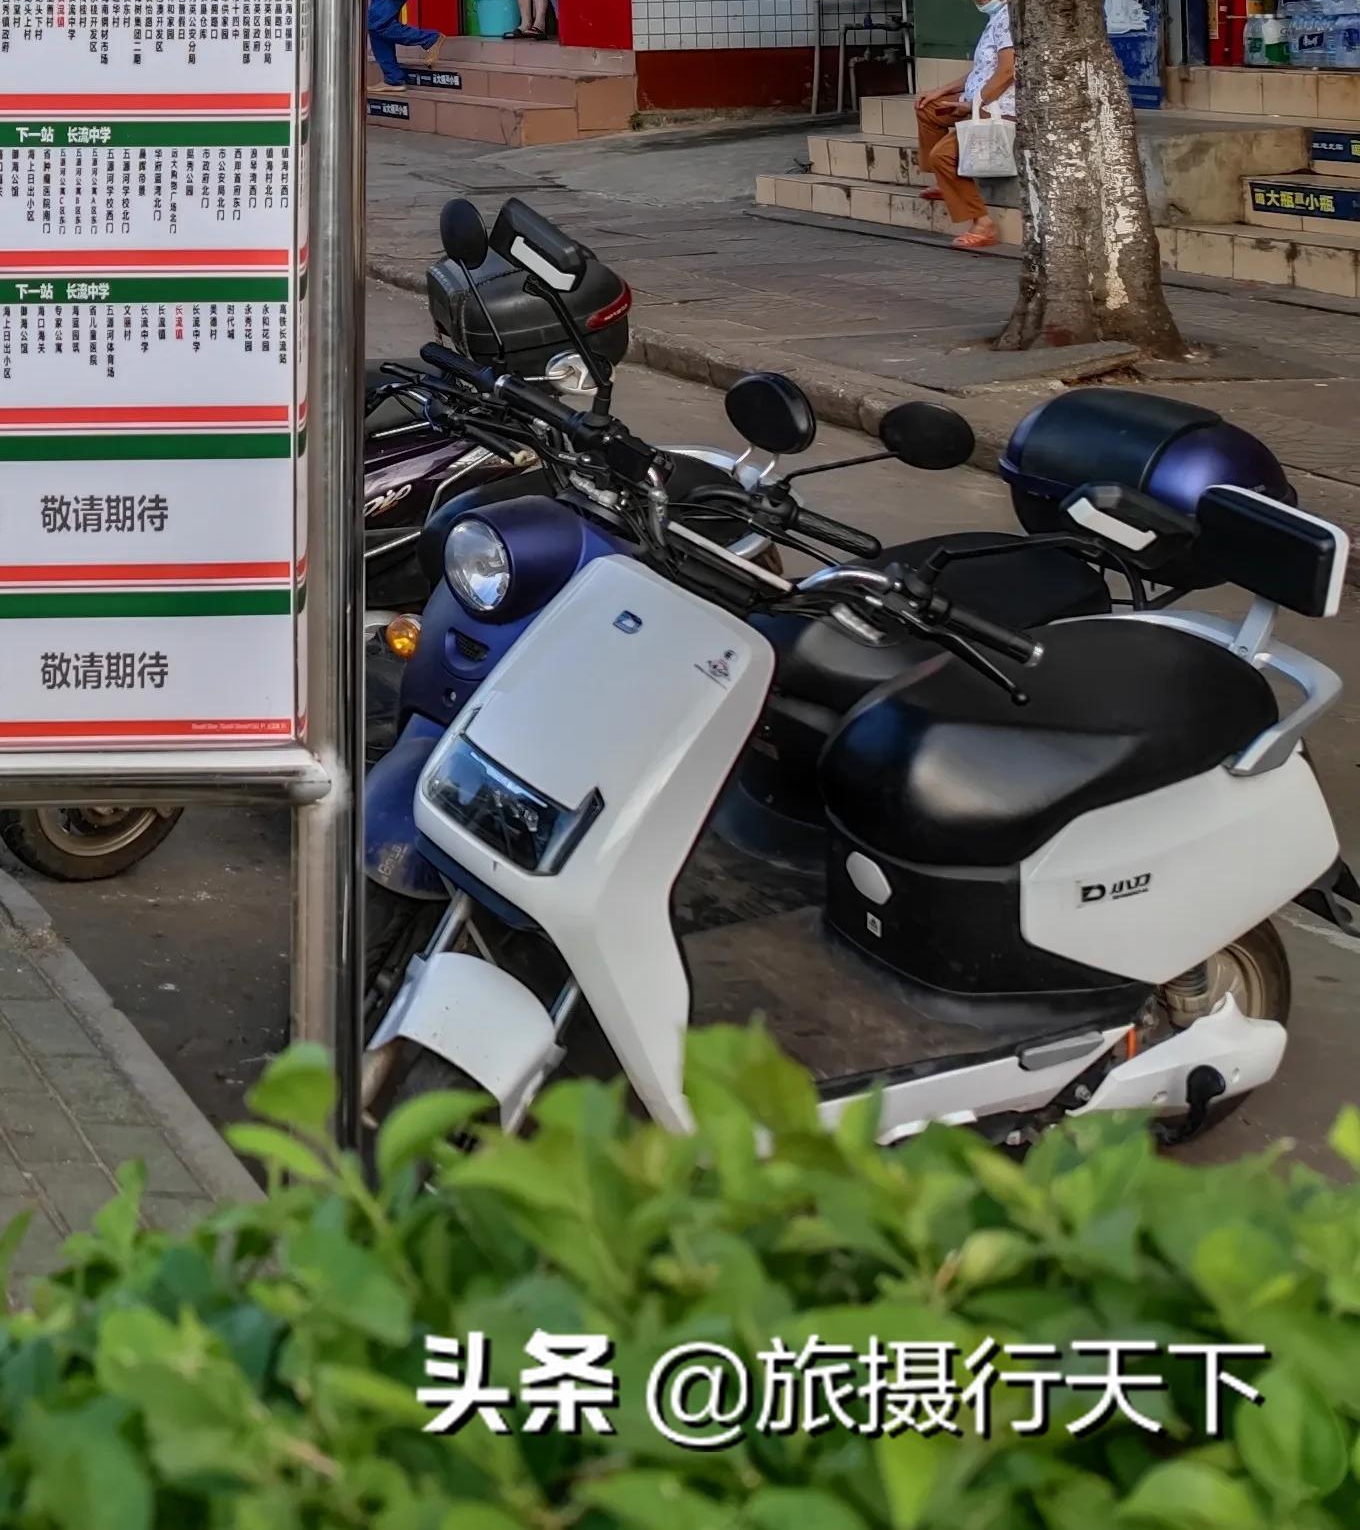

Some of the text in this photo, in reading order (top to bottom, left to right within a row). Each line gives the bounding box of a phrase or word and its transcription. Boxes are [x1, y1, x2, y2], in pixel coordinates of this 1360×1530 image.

[16, 126, 111, 143] 下一站 长流中学
[16, 283, 110, 300] 下一站 长流中学
[40, 494, 169, 534] 敬请期待
[40, 652, 169, 691] 敬请期待
